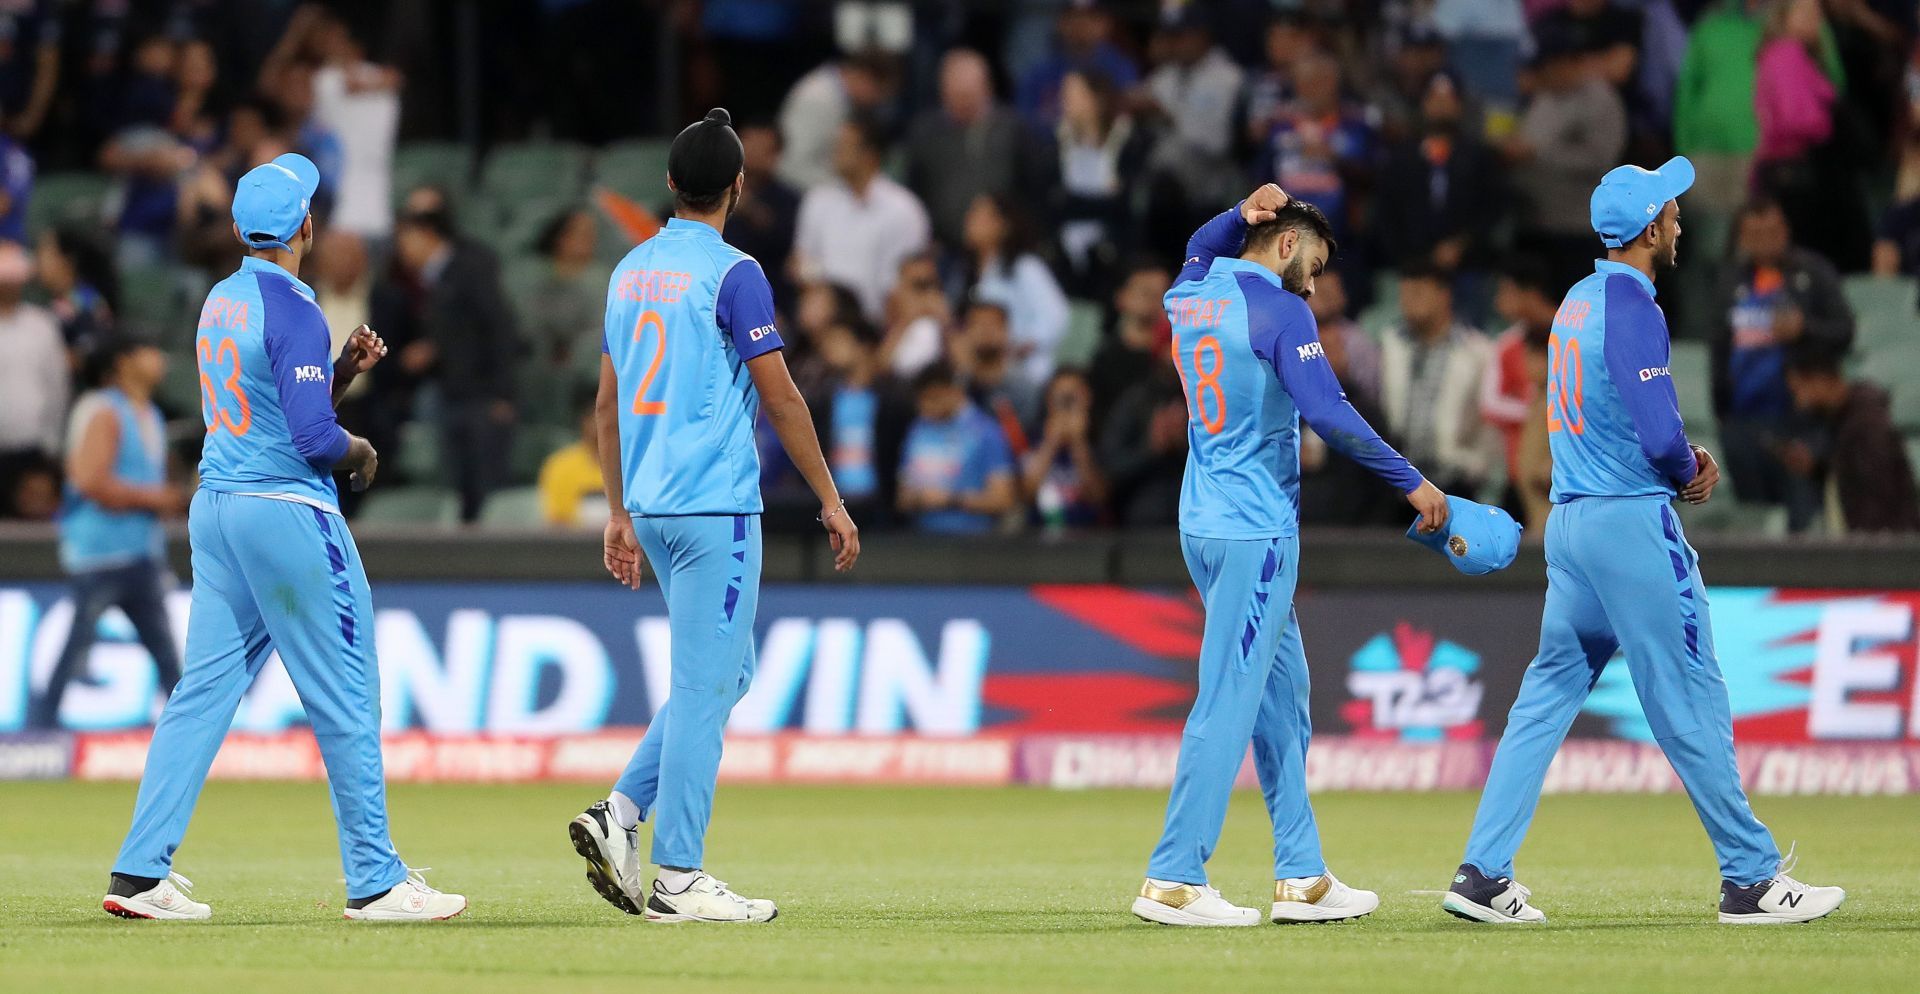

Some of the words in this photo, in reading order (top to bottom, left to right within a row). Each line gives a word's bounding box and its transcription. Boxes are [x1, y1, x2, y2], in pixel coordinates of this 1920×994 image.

[197, 336, 252, 437] 63
[294, 365, 325, 380] MPL
[632, 310, 667, 416] 2
[1171, 333, 1226, 435] 18
[635, 616, 991, 736] WIN
[1806, 600, 1920, 740] E
